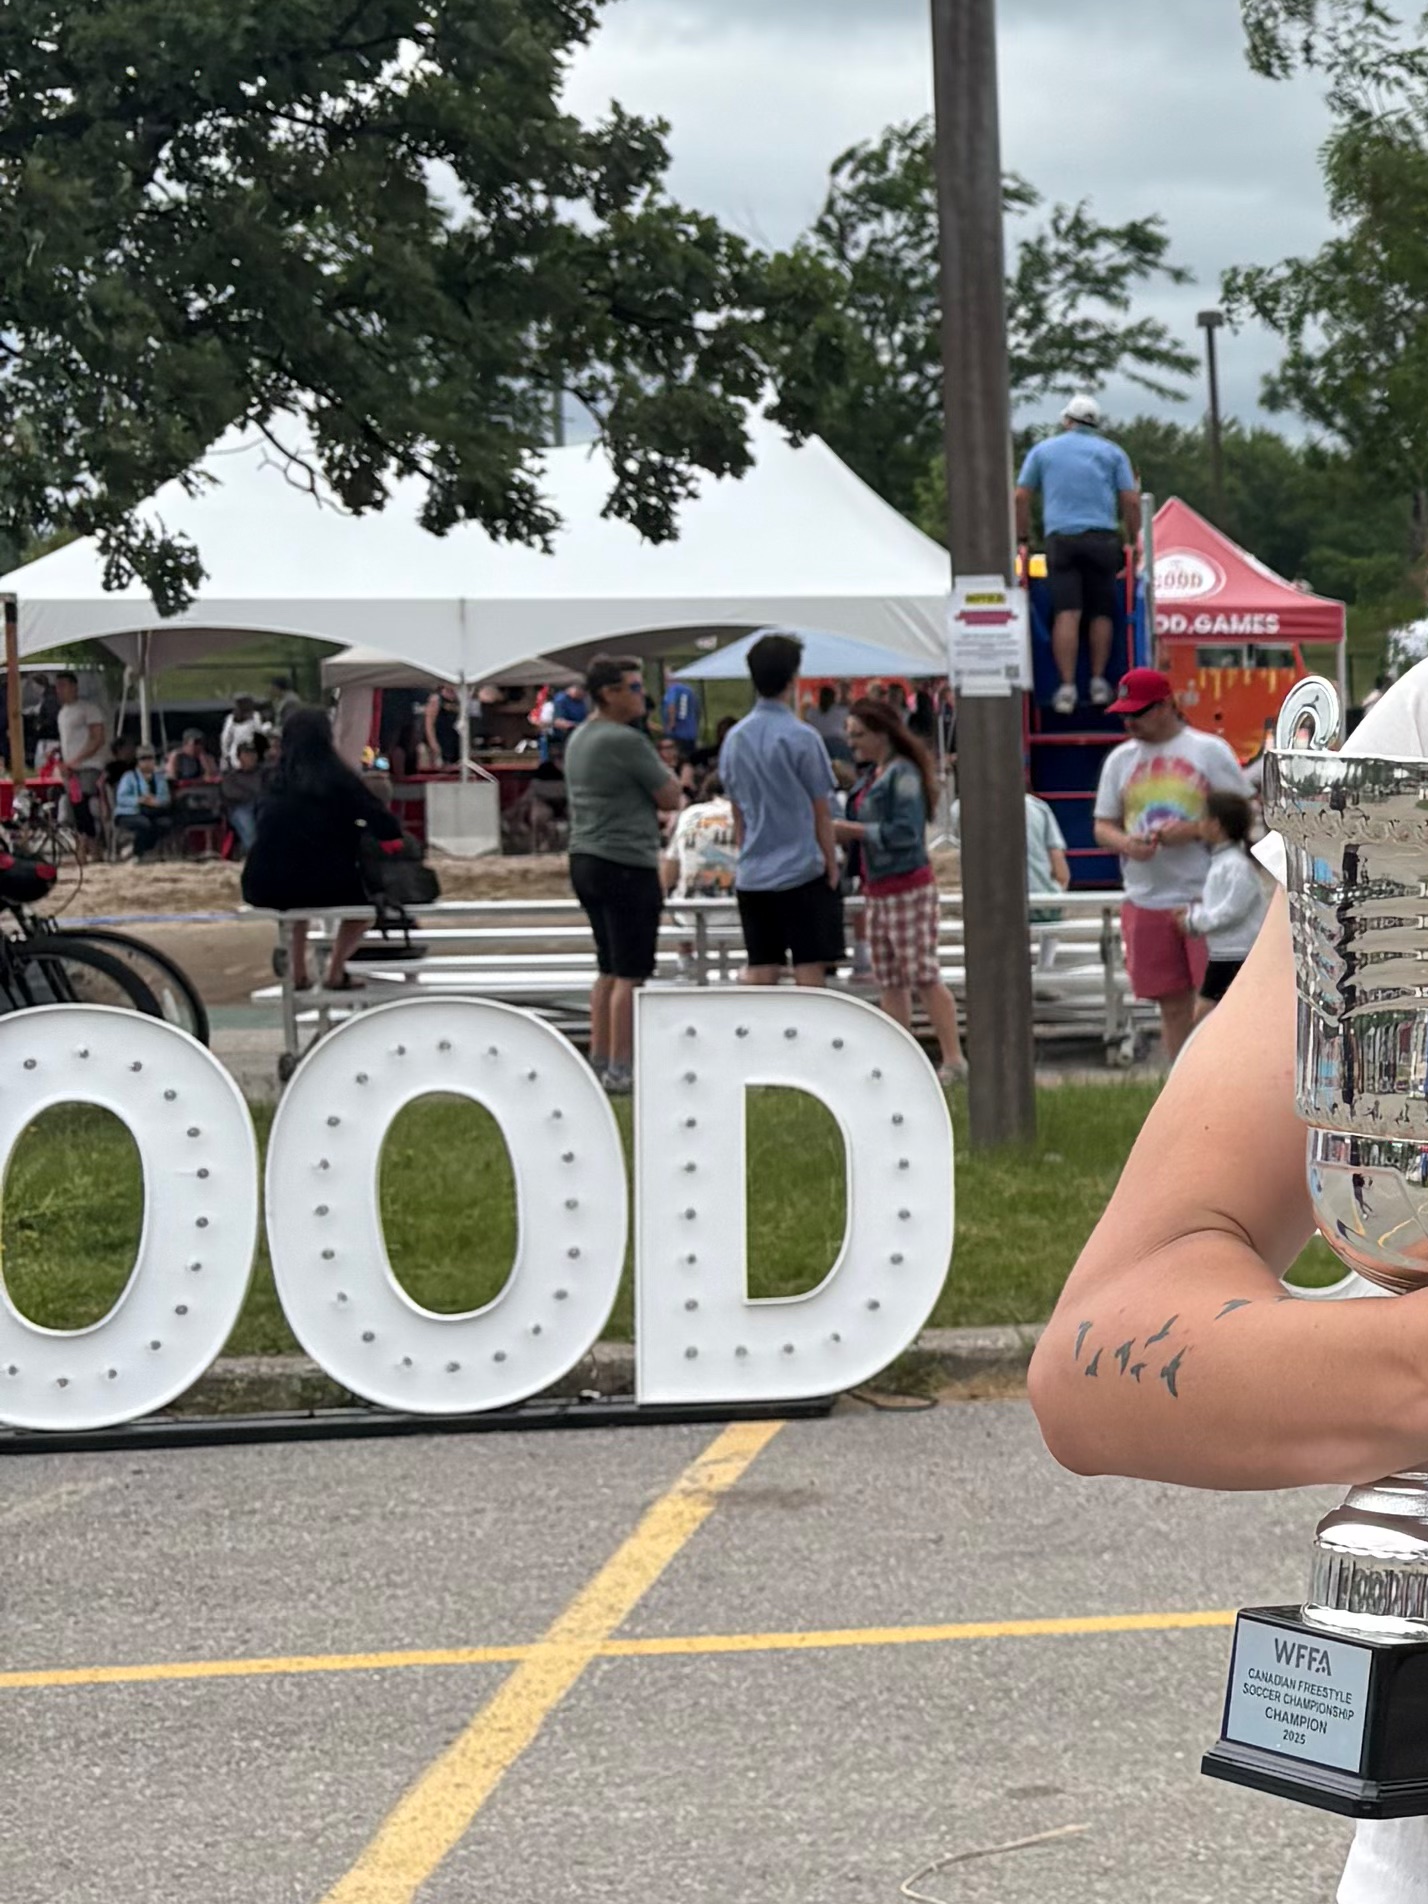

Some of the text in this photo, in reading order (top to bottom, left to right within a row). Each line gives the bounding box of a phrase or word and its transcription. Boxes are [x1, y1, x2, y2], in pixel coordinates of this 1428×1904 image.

[0, 987, 954, 1430] OOD
[1274, 1637, 1332, 1677] WFFA
[1242, 1682, 1355, 1721] SOCCER CHAMPIONSHIP
[1248, 1667, 1353, 1705] CANADIAN FREESTYLE
[1265, 1706, 1328, 1734] CHAMPION
[1283, 1729, 1306, 1745] 2025
